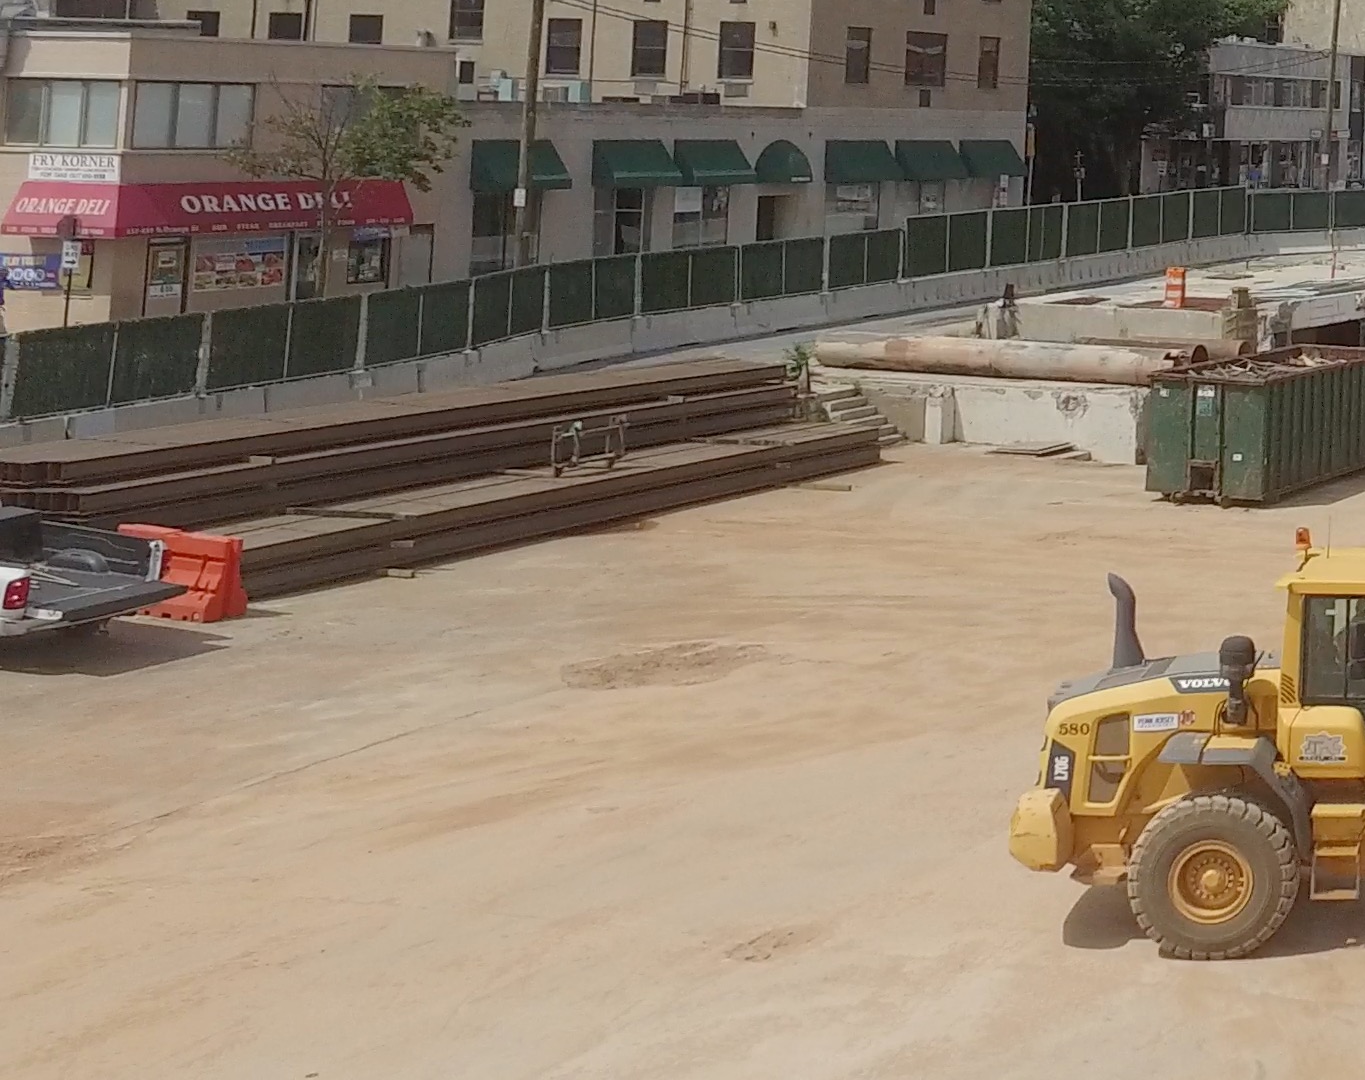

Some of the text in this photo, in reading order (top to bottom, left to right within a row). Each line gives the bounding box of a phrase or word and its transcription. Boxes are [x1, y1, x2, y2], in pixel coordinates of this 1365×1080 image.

[32, 154, 115, 168] FRY KORNER
[16, 197, 111, 216] ORANGE DELI
[181, 192, 292, 214] ORANGE
[1058, 722, 1090, 736] 580
[1053, 754, 1069, 782] L70G
